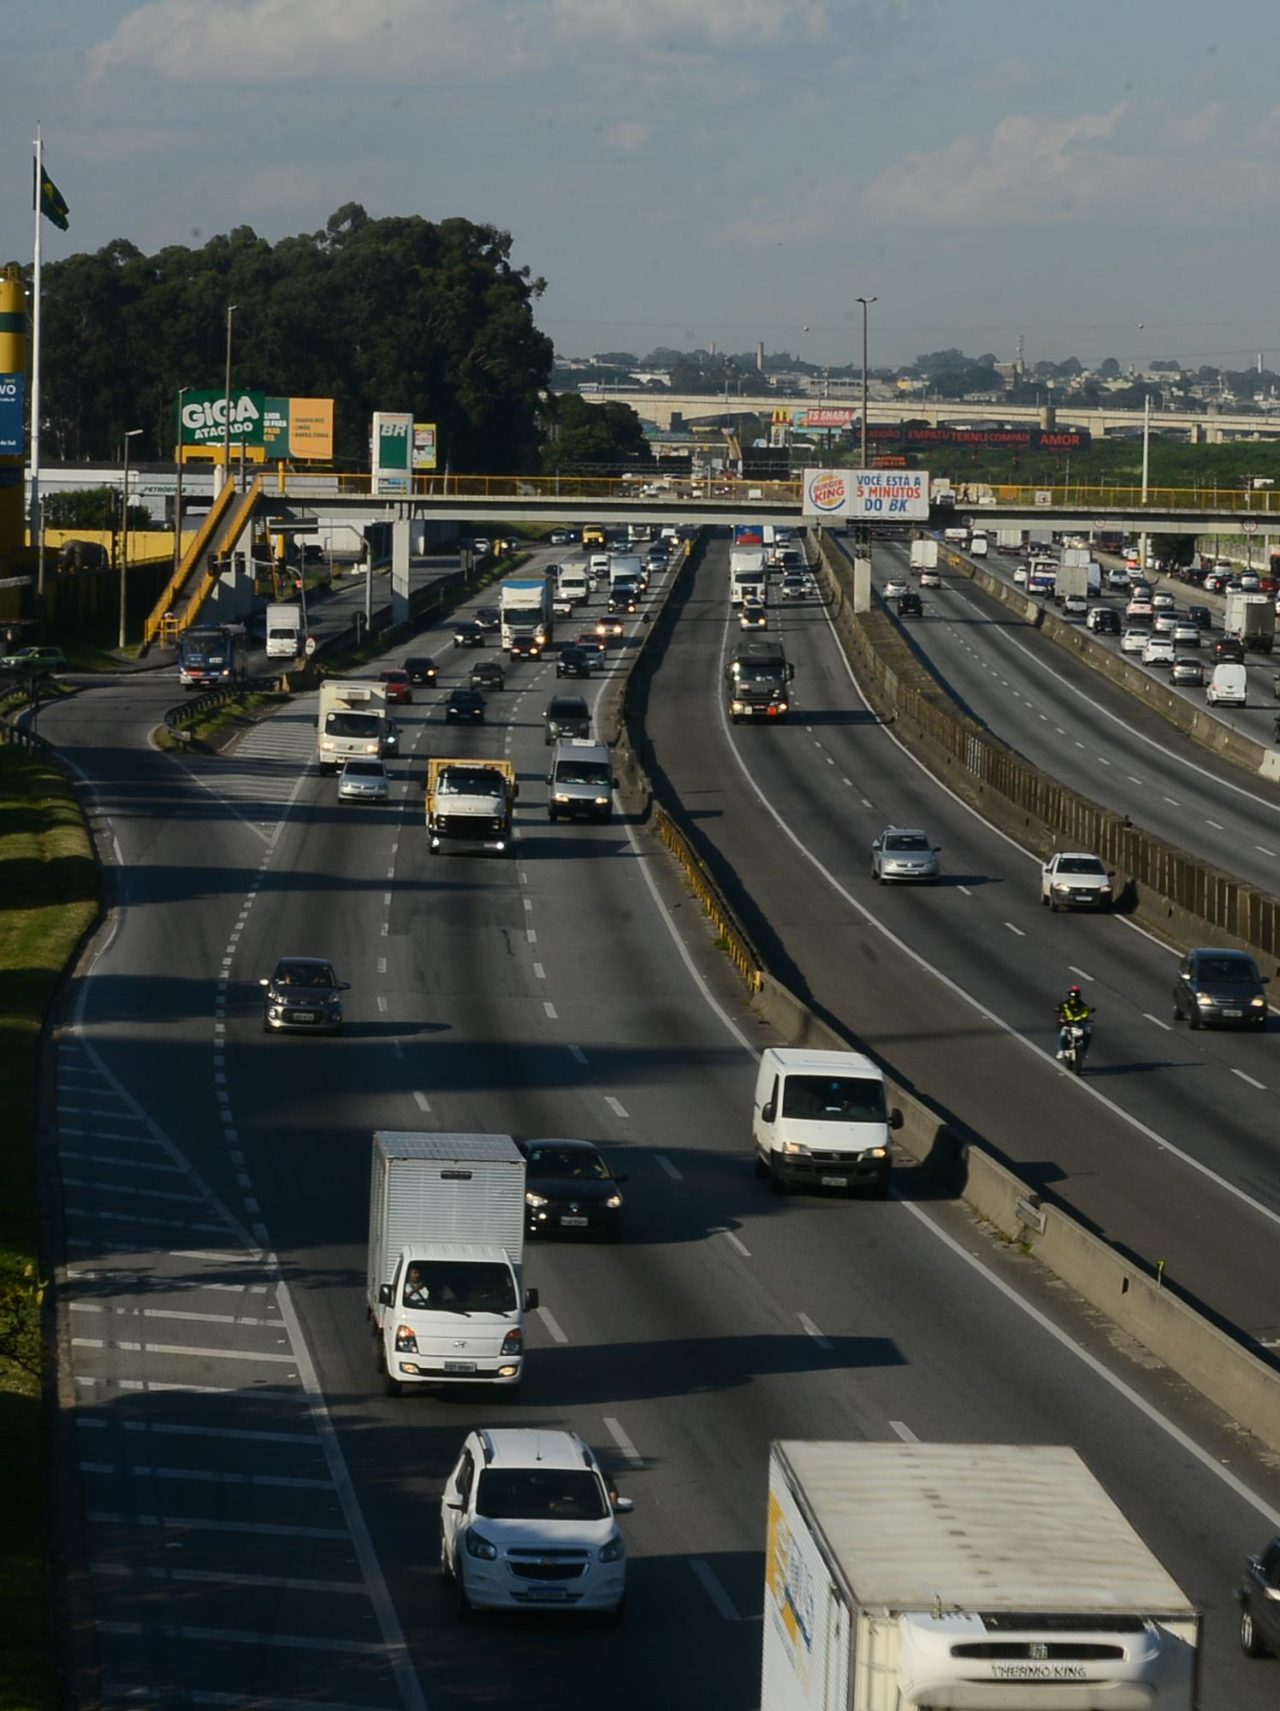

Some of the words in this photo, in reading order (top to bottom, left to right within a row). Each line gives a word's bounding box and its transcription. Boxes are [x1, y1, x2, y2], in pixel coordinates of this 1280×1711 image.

[380, 424, 406, 437] BR
[856, 428, 899, 439] GATIDÃO
[1040, 434, 1080, 445] AMOR
[813, 478, 843, 492] BURGER
[856, 473, 881, 486] VOCÊ
[886, 474, 910, 486] ESTÁ
[914, 477, 921, 486] A
[814, 487, 845, 502] KING
[856, 486, 864, 497] 5
[869, 487, 921, 498] MINUTOS
[864, 499, 883, 511] DO
[889, 499, 908, 512] BK
[991, 1665, 1051, 1678] THERMO
[1054, 1665, 1087, 1678] KING
